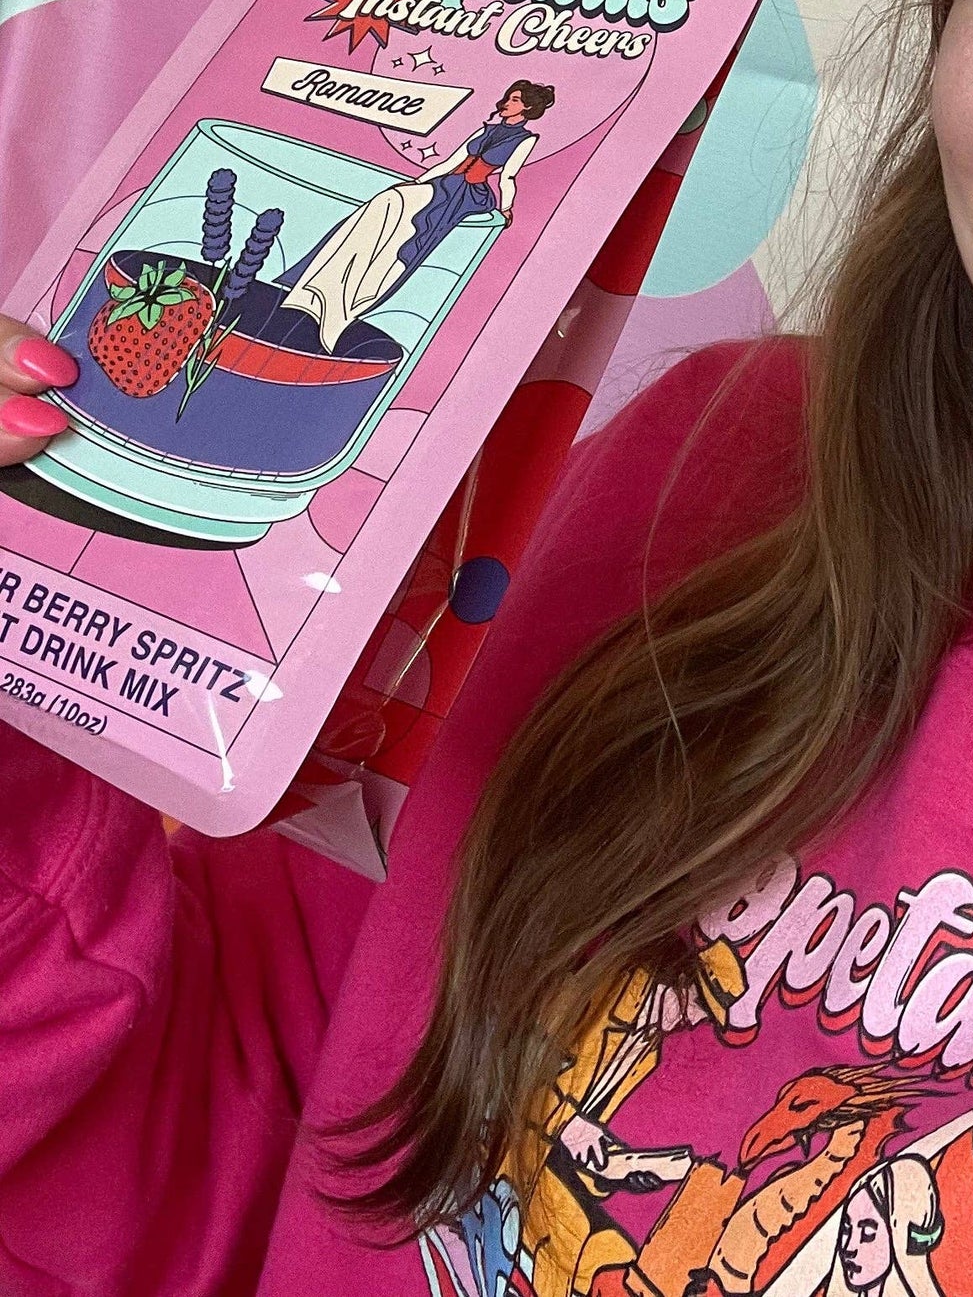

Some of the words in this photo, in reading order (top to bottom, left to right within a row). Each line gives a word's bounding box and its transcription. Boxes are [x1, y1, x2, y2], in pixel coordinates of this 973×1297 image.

[494, 3, 653, 61] Cheers
[291, 68, 425, 117] Romance
[0, 568, 22, 603] R
[22, 582, 133, 648] BERRY
[131, 630, 251, 703] SPRITZ
[20, 624, 119, 690] DRINK
[119, 668, 180, 717] MIX
